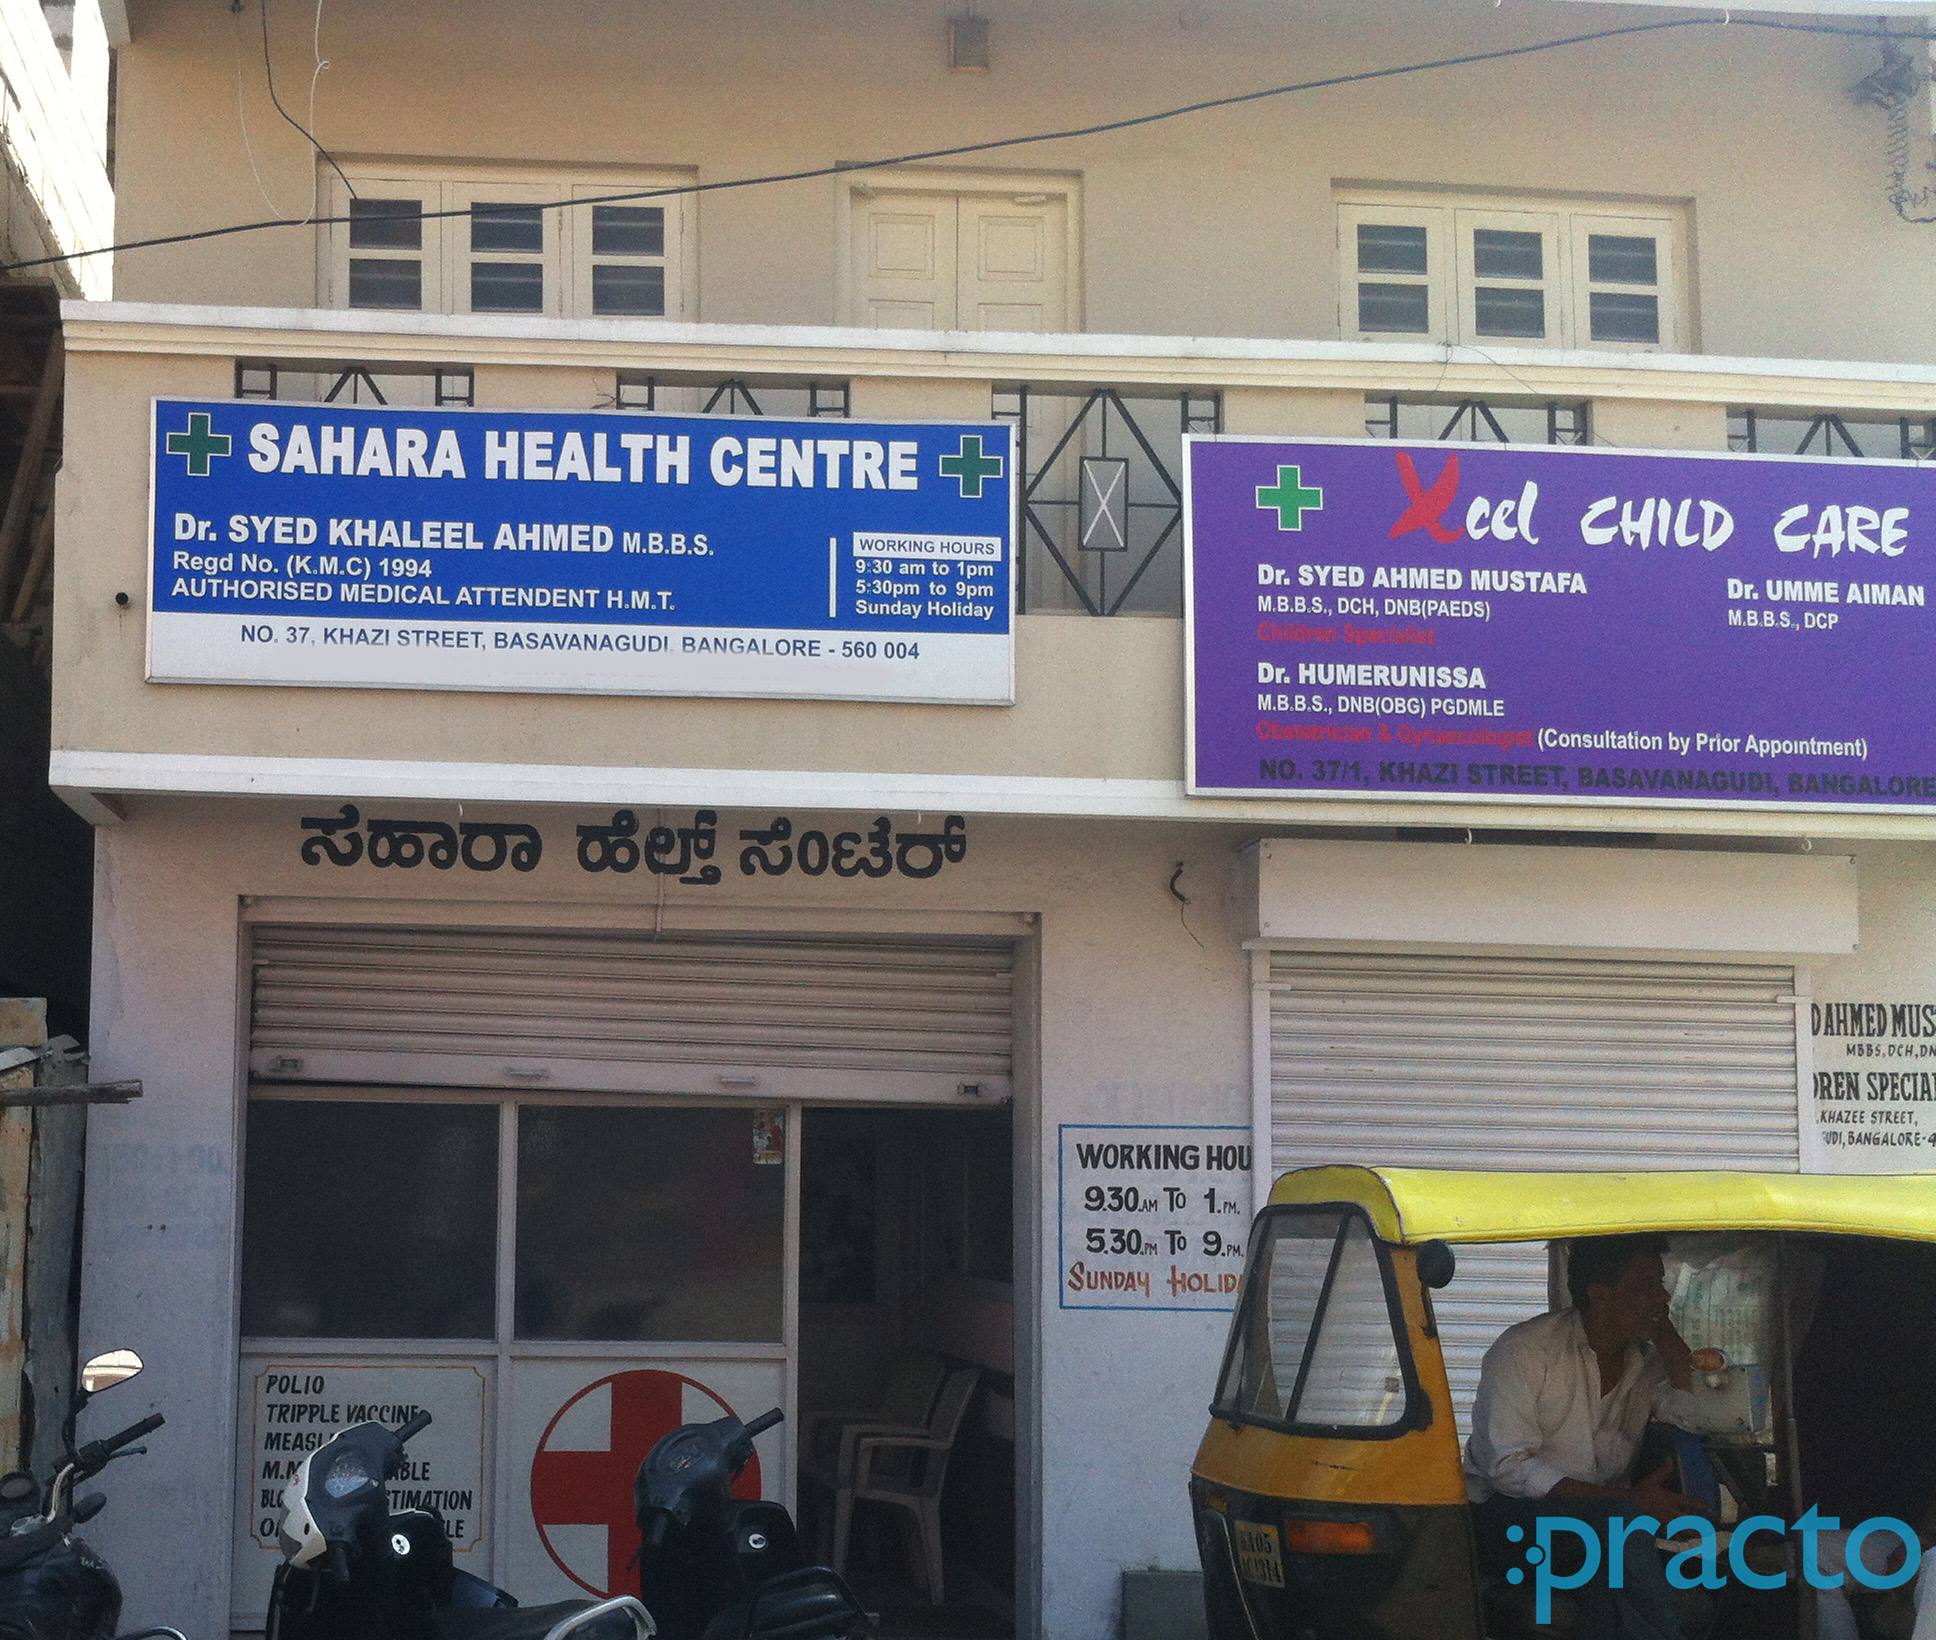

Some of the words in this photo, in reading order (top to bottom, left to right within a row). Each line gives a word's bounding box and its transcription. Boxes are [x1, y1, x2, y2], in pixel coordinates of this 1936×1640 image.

[247, 423, 466, 480] SAHARA
[484, 430, 690, 485] HEALTH
[710, 436, 919, 490] CENTRE
[1388, 450, 1540, 545] Xcel
[1580, 496, 1735, 551] CHILD
[1773, 504, 1910, 559] CARE
[174, 513, 217, 542] Dr.
[229, 515, 318, 545] SYED
[329, 519, 484, 550] KHALEEL
[493, 523, 614, 553] AHMED
[623, 533, 714, 556] M.B.B.S.
[859, 538, 936, 555] WORKING
[941, 540, 996, 556] HOURS
[173, 552, 234, 576] Regd
[241, 554, 279, 575] No.
[287, 555, 372, 581] (K.M.C)
[379, 558, 433, 578] 1994
[855, 560, 892, 576] 9:30
[898, 563, 925, 576] am
[932, 560, 950, 577] to
[956, 561, 994, 581] 1pm
[1257, 564, 1291, 587] Dr.
[1298, 565, 1365, 588] SYED
[1372, 567, 1463, 590] AHMED
[1470, 570, 1588, 594] MUSTAFA
[171, 577, 333, 602] AUTHORISED
[340, 583, 450, 606] MEDICAL
[455, 586, 600, 609] ATTENDENT
[607, 590, 676, 611] H.M.T.
[855, 579, 920, 598] 5:30pm
[928, 581, 947, 597] to
[955, 582, 994, 600] 9pm
[1727, 578, 1759, 601] Dr.
[1766, 579, 1840, 603] UMME
[1846, 583, 1926, 606] AIMAN
[855, 599, 922, 619] Sunday
[927, 601, 994, 621] Holiday
[1337, 597, 1380, 619] DCH,
[1384, 599, 1491, 622] DNB(PAEDS)
[1804, 612, 1839, 630] DCP
[241, 625, 279, 645] NO.
[323, 627, 390, 648] KHAZI
[396, 629, 487, 652] STREET,
[681, 636, 821, 657] BANGALORE
[841, 641, 878, 660] 560
[883, 642, 920, 660] 004
[1257, 662, 1291, 685] Dr.
[1298, 662, 1487, 689] HUMERUNISSA
[1337, 696, 1427, 719] DNB(OBG)
[1431, 699, 1505, 717] PGDMLE
[1538, 727, 1663, 752] (Consultation
[1668, 731, 1690, 756] by
[1696, 733, 1740, 753] Prior
[1745, 734, 1868, 761] Appointment)
[1259, 758, 1303, 781] NO.
[1379, 761, 1458, 785] KHAZI
[1467, 763, 1569, 789] STREET,
[1788, 772, 1936, 798] BANGALORE
[1824, 1003, 1888, 1037] AHMED
[1871, 1111, 1918, 1127] STREET,
[1076, 1143, 1200, 1171] WORKING
[266, 1375, 324, 1394] POLIO
[267, 1404, 340, 1424] TRIPPLE
